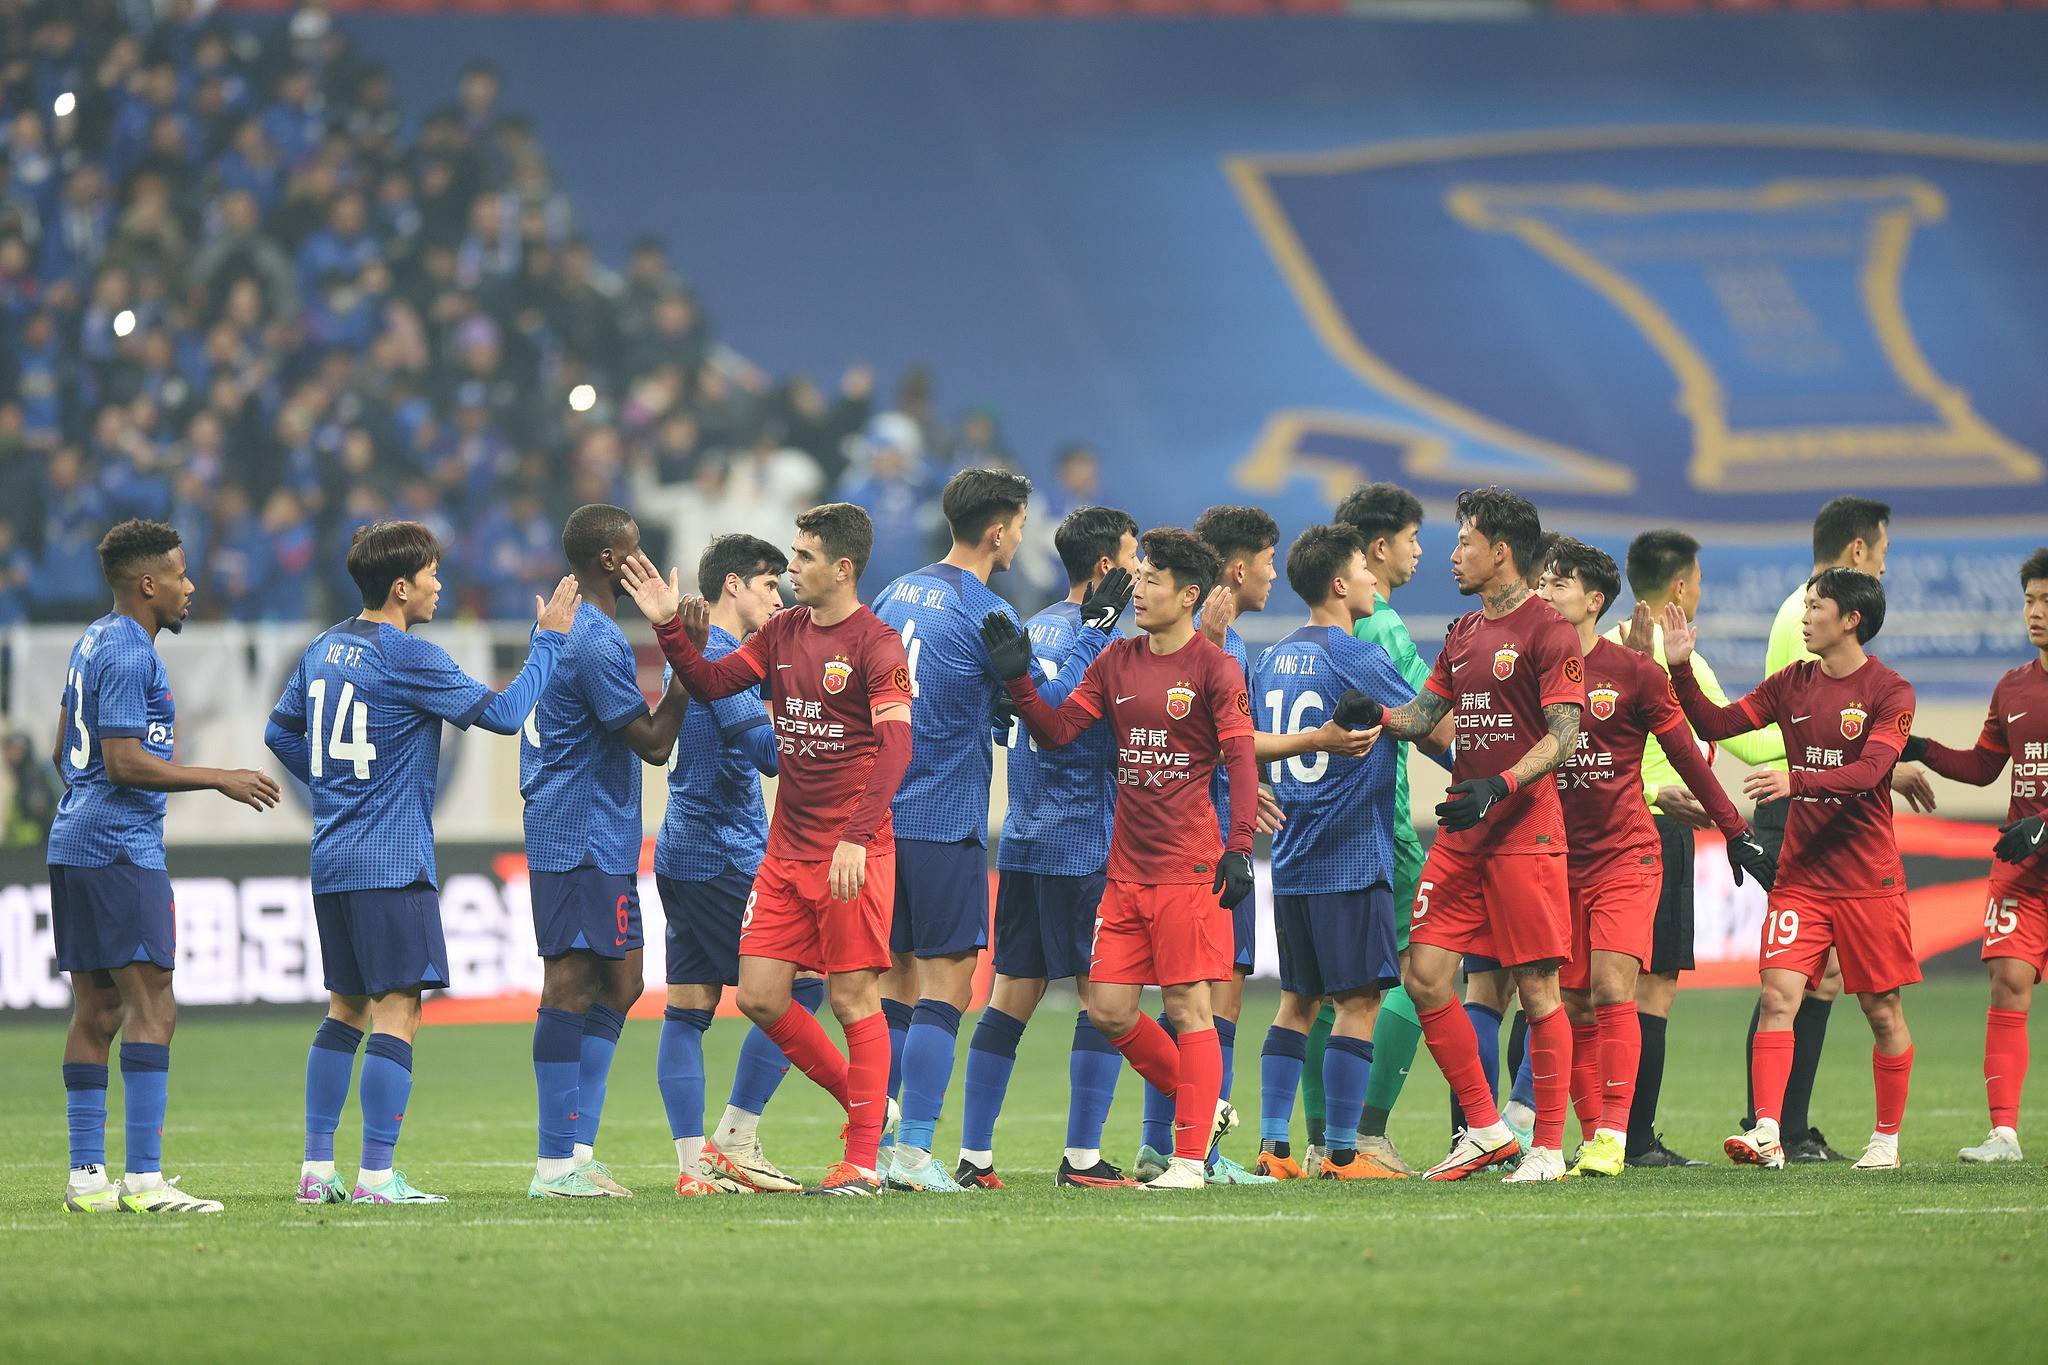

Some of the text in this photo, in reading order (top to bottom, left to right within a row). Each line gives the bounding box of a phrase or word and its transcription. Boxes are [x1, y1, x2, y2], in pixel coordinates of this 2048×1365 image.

[891, 582, 923, 604] JIANG
[325, 643, 363, 667] XIE P.F.
[1274, 655, 1298, 675] YANG
[785, 697, 822, 720] 荣威
[1461, 692, 1491, 710] 荣威
[308, 678, 376, 779] 14
[777, 716, 844, 738] ROEWE
[1454, 714, 1513, 728] ROEWE
[1129, 728, 1167, 748] 荣威
[1265, 689, 1329, 783] 16
[1119, 748, 1190, 766] ROEWE
[1806, 746, 1844, 767] 荣威
[2024, 742, 2048, 760] 荣
[2014, 763, 2048, 776] ROE
[742, 890, 758, 928] 8
[1413, 881, 1434, 919] 5
[616, 895, 629, 933] 6
[1983, 897, 2019, 934] 45
[1767, 909, 1799, 945] 19
